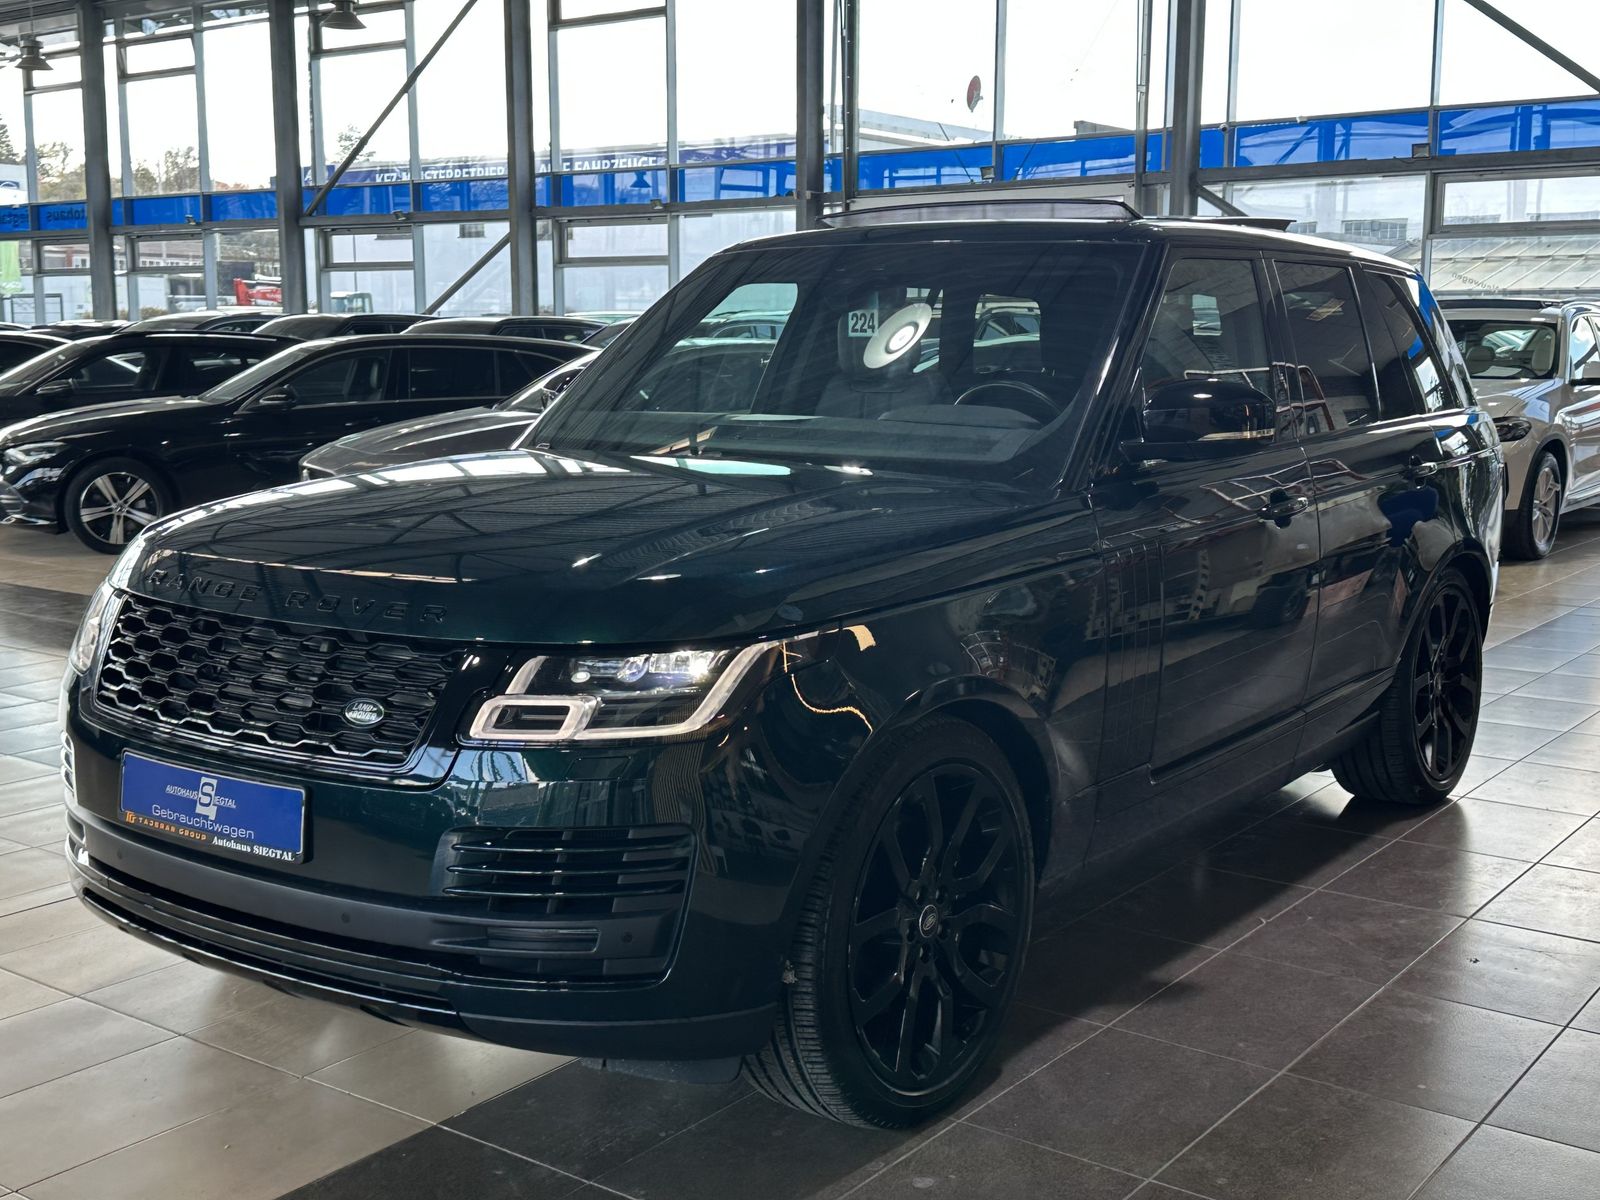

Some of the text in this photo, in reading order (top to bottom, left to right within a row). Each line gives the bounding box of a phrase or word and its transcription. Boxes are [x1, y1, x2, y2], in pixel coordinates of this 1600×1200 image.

[850, 312, 876, 334] 224
[148, 569, 448, 624] RANGE ROVER
[349, 710, 377, 720] ROVER
[165, 784, 199, 800] AUTOHAUS
[151, 804, 254, 840] Gebrauchtwagen
[178, 828, 207, 841] GROUP
[212, 836, 295, 862] Autohaus SIEGTAL
